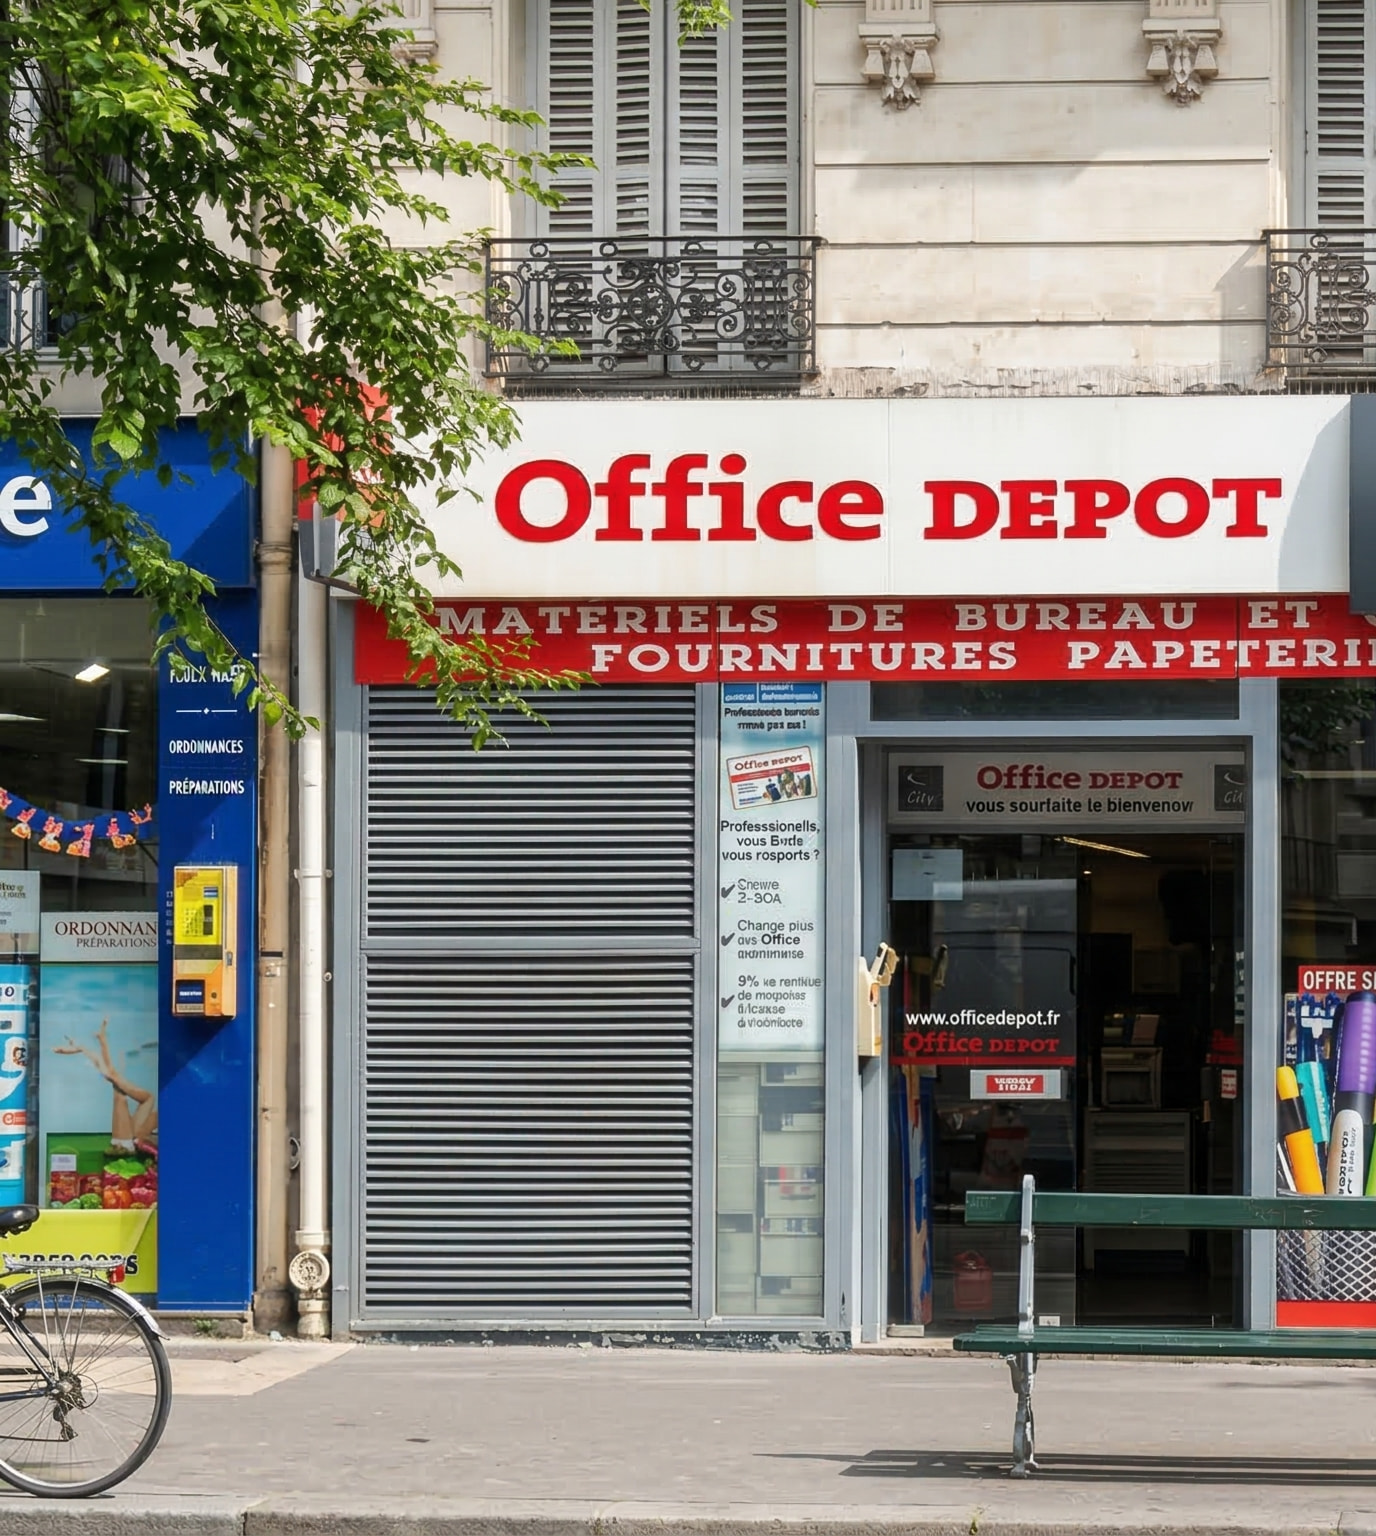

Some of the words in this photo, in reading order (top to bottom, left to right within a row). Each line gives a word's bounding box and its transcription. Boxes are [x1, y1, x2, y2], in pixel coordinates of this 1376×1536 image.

[495, 453, 885, 544] Office
[923, 477, 1282, 539] DEPOT
[436, 605, 779, 635] MATERIELS
[827, 603, 905, 633] DE
[954, 601, 1198, 632] BUREAU
[1246, 600, 1319, 630] ET
[590, 641, 1017, 673] FOURNITURES
[169, 739, 244, 754] ORDONNANCES
[169, 777, 245, 795] PRÉPARATIONS
[976, 764, 1082, 791] Office
[1088, 771, 1184, 790] DEPOT
[966, 800, 1006, 814] vous
[736, 837, 767, 847] vous
[721, 851, 753, 861] vous
[54, 921, 158, 936] ORDONNAN
[737, 919, 785, 934] Change
[1303, 970, 1357, 990] OFFRE
[905, 1009, 1061, 1029] www.officedepot.fr
[903, 1031, 984, 1053] Office
[988, 1039, 1060, 1053] DEPOT
